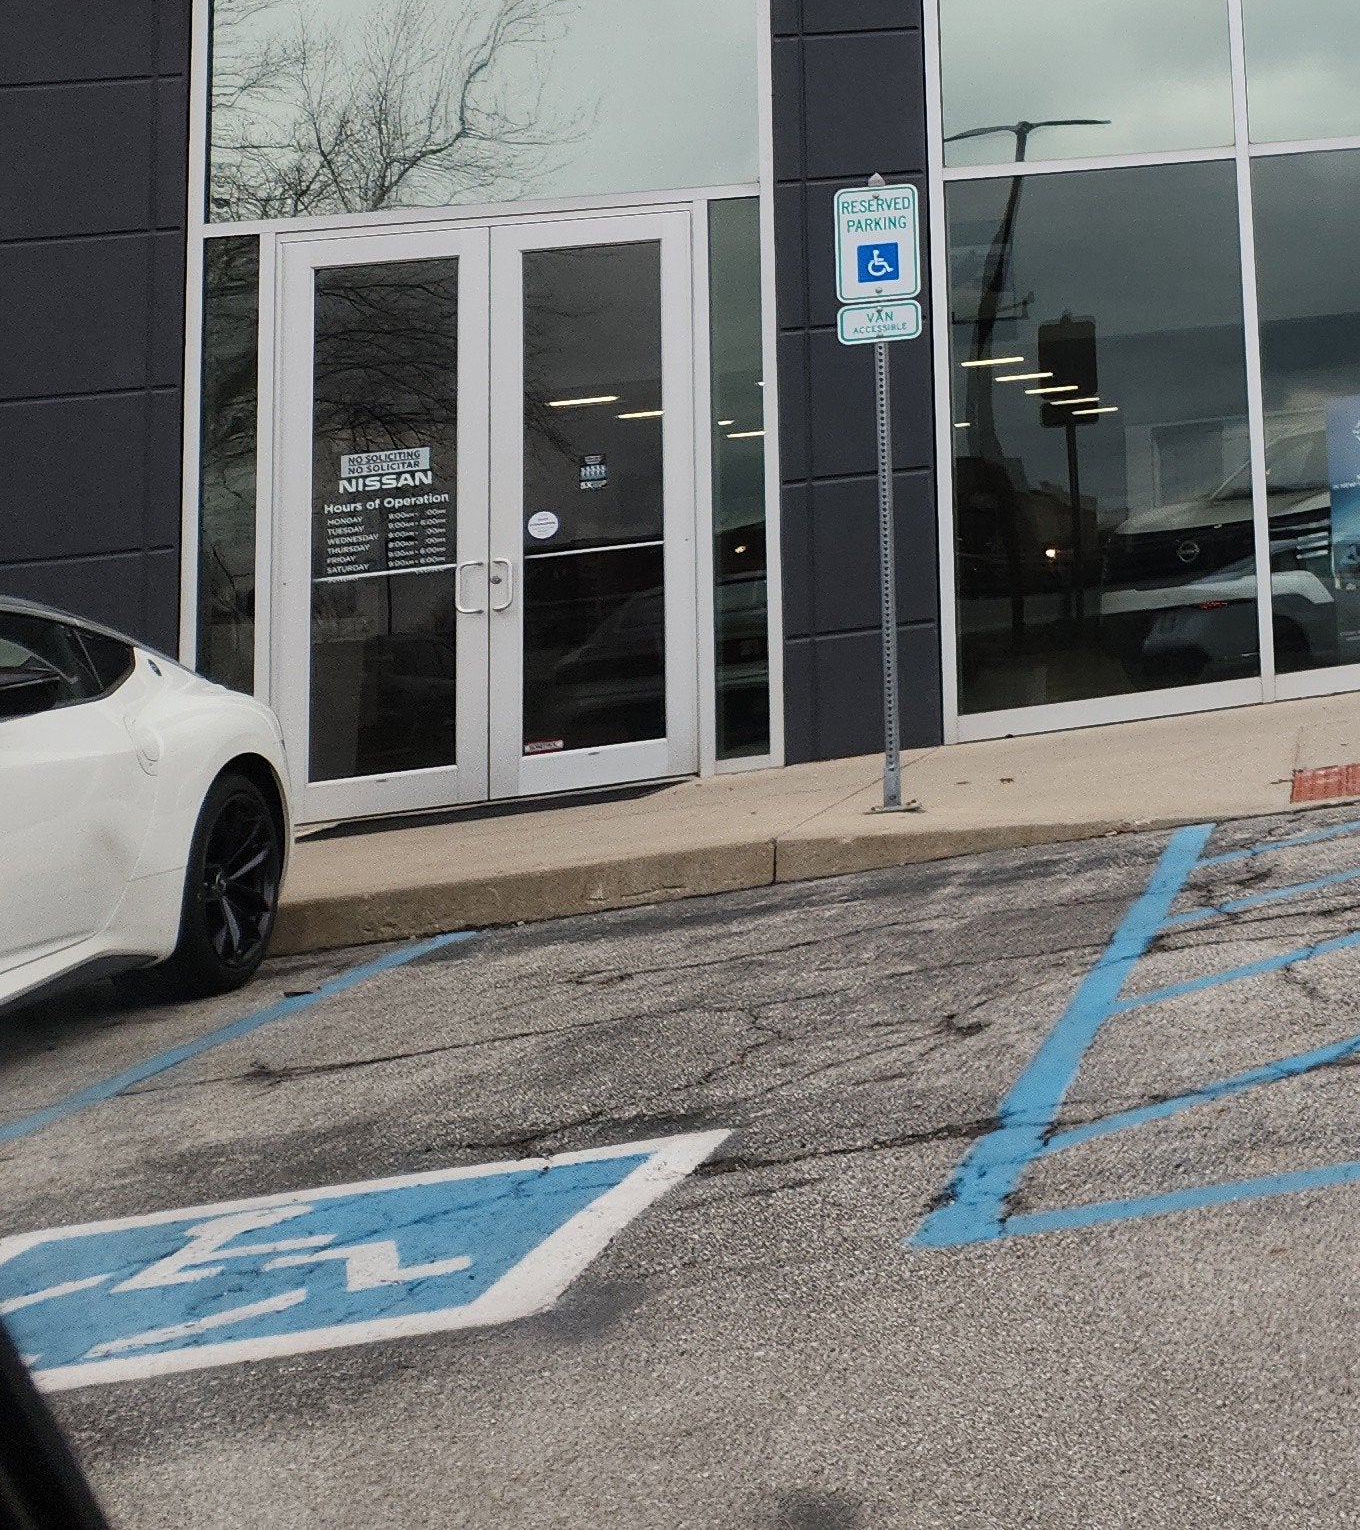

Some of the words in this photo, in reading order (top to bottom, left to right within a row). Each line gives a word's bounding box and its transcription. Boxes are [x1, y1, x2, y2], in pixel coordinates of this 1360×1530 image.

[841, 196, 911, 215] RESERVED
[846, 215, 907, 233] PARKING
[866, 311, 894, 323] VAN
[853, 322, 908, 335] ACCESSIBLE
[348, 456, 363, 466] NO
[365, 450, 421, 464] SOLICITING
[347, 466, 363, 475] NO
[366, 460, 421, 474] SOLICITAR
[338, 470, 433, 494] NISSAN
[324, 502, 363, 515] Hours
[366, 499, 380, 510] of
[383, 492, 450, 510] Operation
[327, 516, 363, 526] MONDAY
[327, 525, 366, 536] TUESDAY
[327, 543, 371, 555] THURSDAY
[326, 555, 358, 565] FRIDAY
[326, 563, 370, 575] SATURDAY
